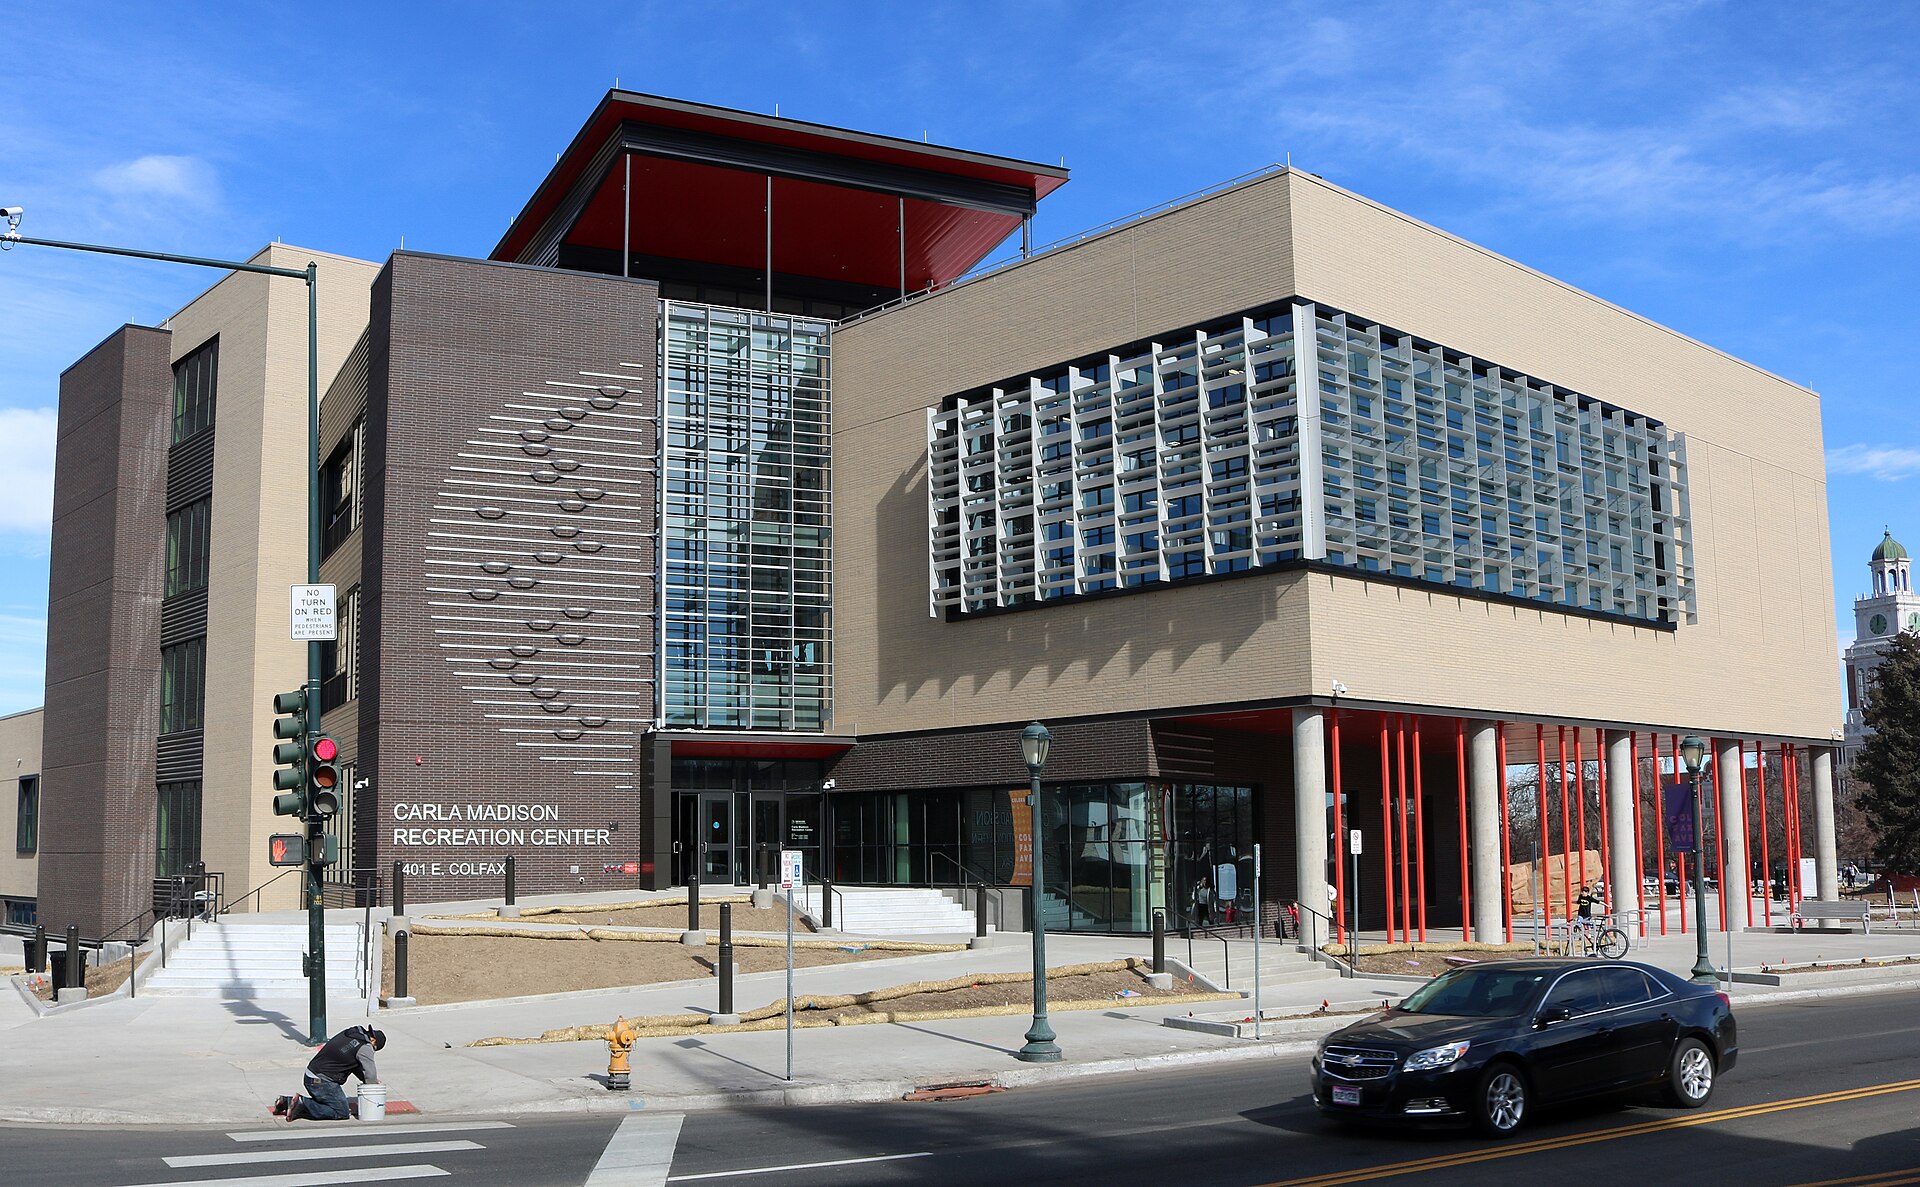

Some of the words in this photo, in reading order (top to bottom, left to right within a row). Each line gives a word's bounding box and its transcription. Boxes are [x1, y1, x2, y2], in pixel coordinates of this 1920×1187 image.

[393, 803, 463, 821] CARLA
[467, 804, 559, 821] MADISON
[393, 828, 525, 846] RECREATION
[530, 828, 611, 846] CENTER
[1018, 833, 1032, 842] COL
[1019, 843, 1032, 852] FAX
[1019, 854, 1032, 863] AVE
[431, 863, 445, 876] E.
[448, 862, 507, 876] COLFAX
